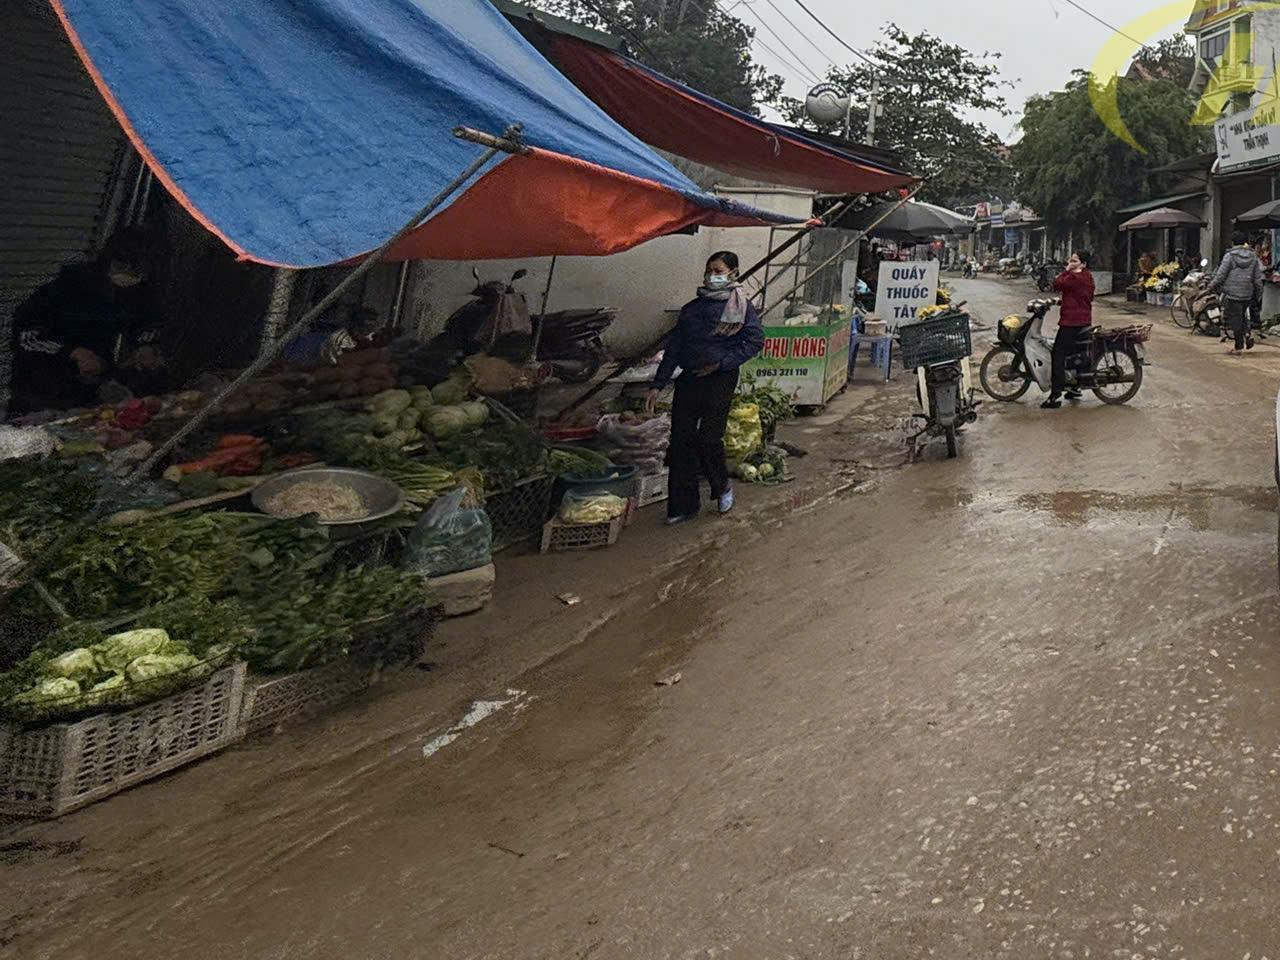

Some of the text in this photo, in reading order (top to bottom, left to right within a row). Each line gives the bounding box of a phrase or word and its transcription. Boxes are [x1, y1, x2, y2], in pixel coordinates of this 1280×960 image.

[886, 283, 928, 299] THUỐC
[894, 304, 917, 318] TÂY
[792, 334, 827, 358] NÔNG
